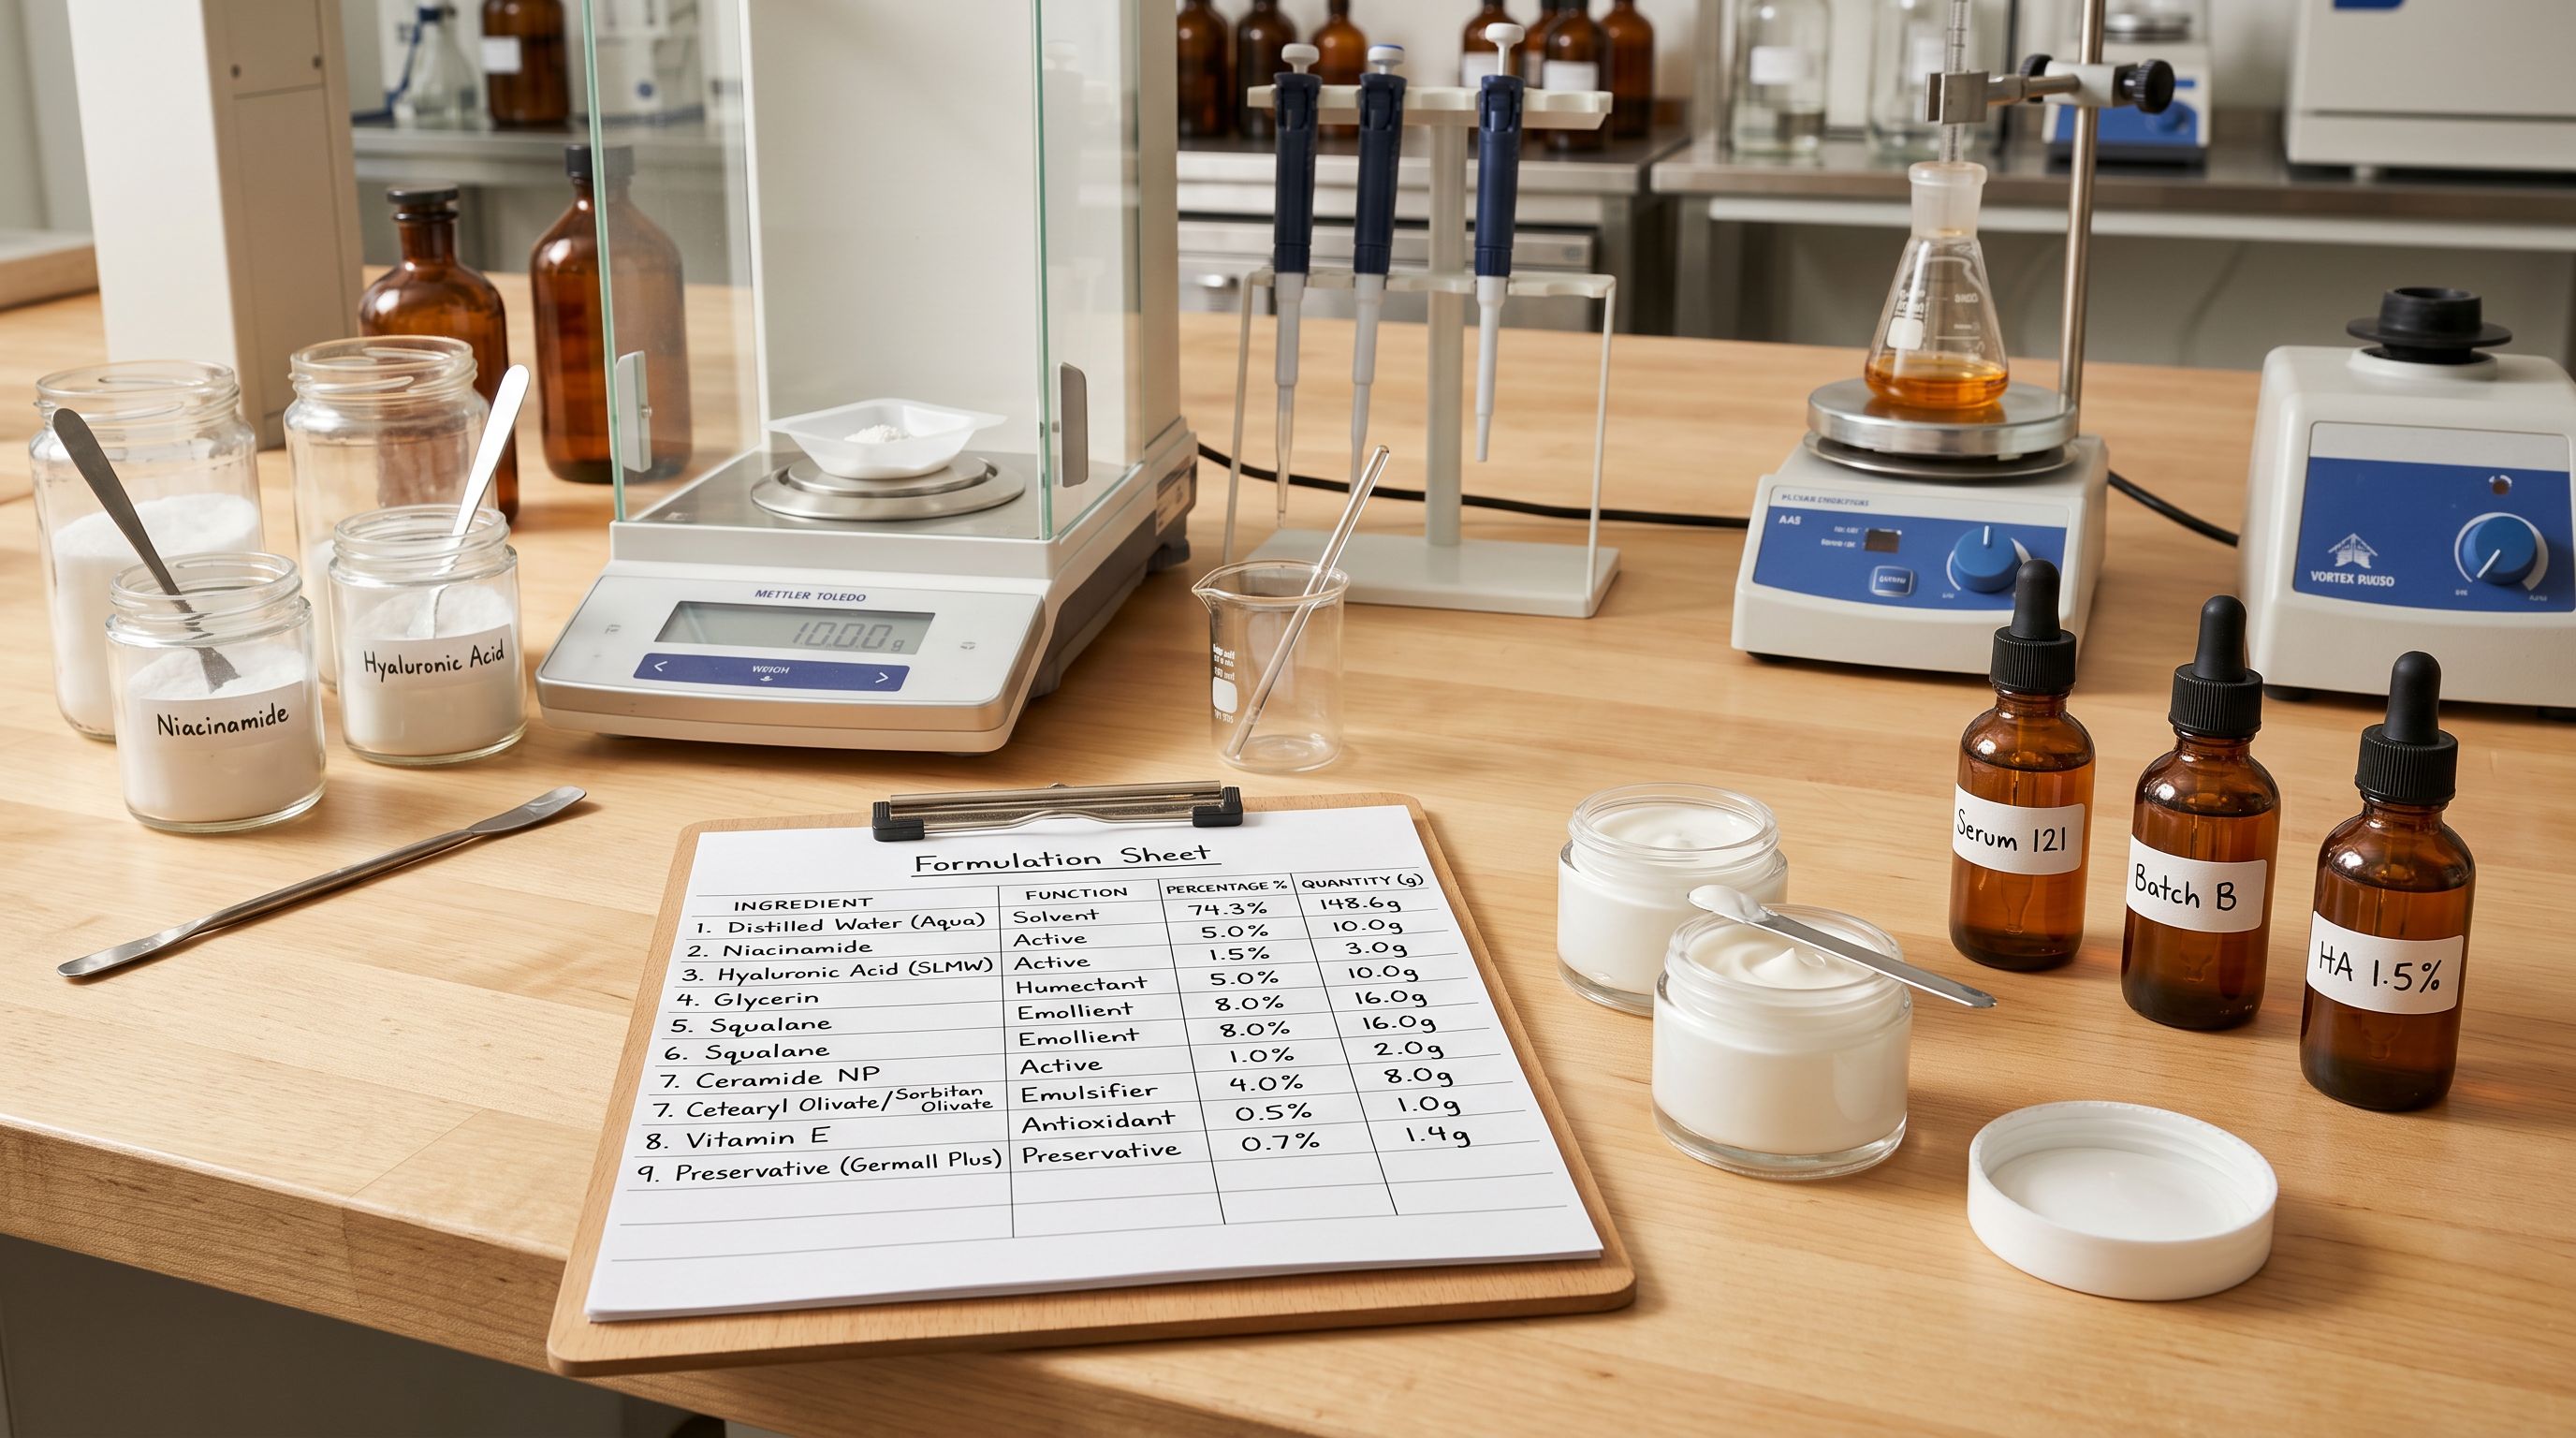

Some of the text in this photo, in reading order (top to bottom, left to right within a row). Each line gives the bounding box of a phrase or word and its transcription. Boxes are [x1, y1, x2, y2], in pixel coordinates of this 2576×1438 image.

[2310, 570, 2354, 585] VORTEX
[754, 589, 867, 602] METTLER TOLEDO
[891, 639, 905, 653] g
[363, 638, 505, 683] Hyaluronic Acid
[156, 702, 289, 737] Niacinamide
[1957, 808, 2066, 853] Serum 121
[915, 844, 1211, 873] Formulation Sheet
[1166, 880, 1288, 895] PERCENTAGE %
[1301, 873, 1424, 889] QUANTITY (g)
[2135, 862, 2237, 912] Batch B
[1025, 887, 1128, 901] FUNCTION
[734, 897, 873, 912] INGREDIENT
[1187, 901, 1267, 917] 74.3%
[1320, 896, 1401, 914] 148.6g
[697, 912, 986, 933] 1. Distilled Water (Aqua)
[1013, 908, 1100, 924] Solvent
[1201, 923, 1269, 939] 5.0%
[1333, 918, 1403, 935] 10.0g
[687, 939, 873, 958] 2. Niacinamide
[1013, 932, 1088, 947] Active
[1209, 946, 1270, 961] 1.5%
[1345, 941, 1408, 959] 3.0g
[681, 956, 993, 987] 3. Hyaluronic Acid (SLMW)
[1014, 956, 1091, 971] Active
[2320, 940, 2442, 994] HA 1.5%
[1210, 970, 1280, 986] 5.0%
[1348, 964, 1419, 983] 10.0g
[1016, 976, 1148, 994] Humectant
[676, 992, 819, 1012] 4. Glycerin
[1214, 994, 1284, 1012] 8.0%
[1354, 990, 1427, 1008] 16.0g
[1017, 1002, 1134, 1020] Emollient
[670, 1017, 832, 1038] 5. Squalane
[1220, 1020, 1291, 1038] 8.0%
[1362, 1015, 1437, 1034] 16.0g
[1018, 1027, 1140, 1047] Emollient
[664, 1043, 830, 1066] 6. Squalane
[1230, 1047, 1295, 1064] 1.0%
[1373, 1040, 1444, 1060] 2.0g
[1019, 1058, 1104, 1075] Active
[660, 1065, 881, 1089] 7. Ceramide NP
[1229, 1073, 1304, 1093] 4.0%
[1383, 1067, 1454, 1088] 8.0g
[1021, 1082, 1159, 1103] Emulsifier
[652, 1102, 673, 1118] 7.
[686, 1097, 787, 1121] Cetearyl
[921, 1097, 994, 1113] Olivate
[1236, 1102, 1312, 1122] 0.5%
[1398, 1095, 1461, 1117] 1.0g
[1021, 1109, 1177, 1134] Antioxidant
[646, 1125, 831, 1151] 8. Vitamin E
[1241, 1131, 1320, 1152] 0.7%
[1406, 1125, 1471, 1149] 1.4g
[1022, 1142, 1182, 1164] Preservative
[637, 1148, 1003, 1182] 9. Preservative (Germall Plus)
